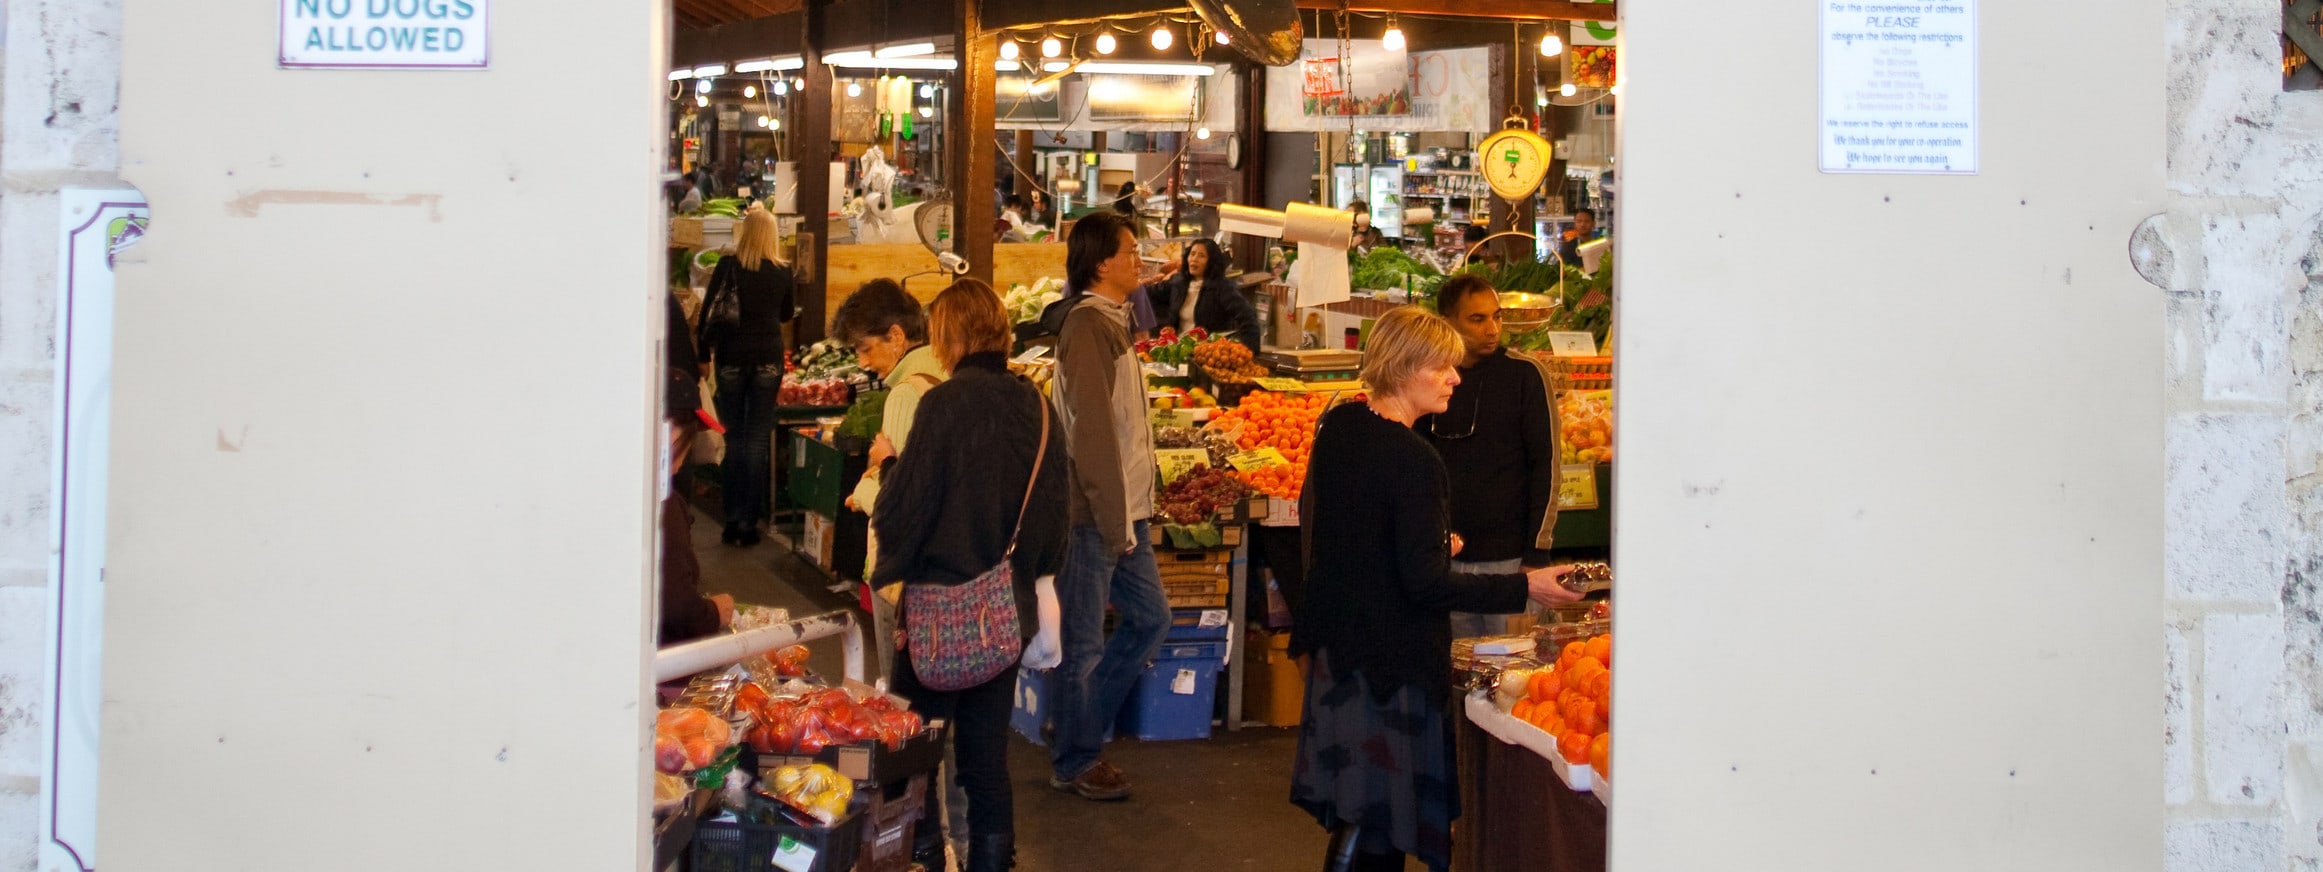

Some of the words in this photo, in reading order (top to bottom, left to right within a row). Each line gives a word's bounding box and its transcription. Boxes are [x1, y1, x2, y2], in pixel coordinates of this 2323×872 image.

[296, 0, 351, 20] NO
[367, 0, 475, 20] DOGS
[1830, 3, 1845, 12] For
[1848, 3, 1861, 13] the
[1865, 4, 1921, 13] convenience
[1924, 4, 1933, 13] of
[1935, 5, 1964, 14] others
[1866, 16, 1920, 28] PLEASE
[305, 26, 464, 51] ALLOWED
[1831, 32, 1864, 41] observe
[1866, 32, 1879, 41] the
[1881, 32, 1917, 43] following
[1919, 33, 1963, 42] restrictions
[1827, 119, 1838, 128] We
[1871, 120, 1884, 129] the
[1905, 121, 1912, 129] to
[1915, 120, 1938, 129] refuse
